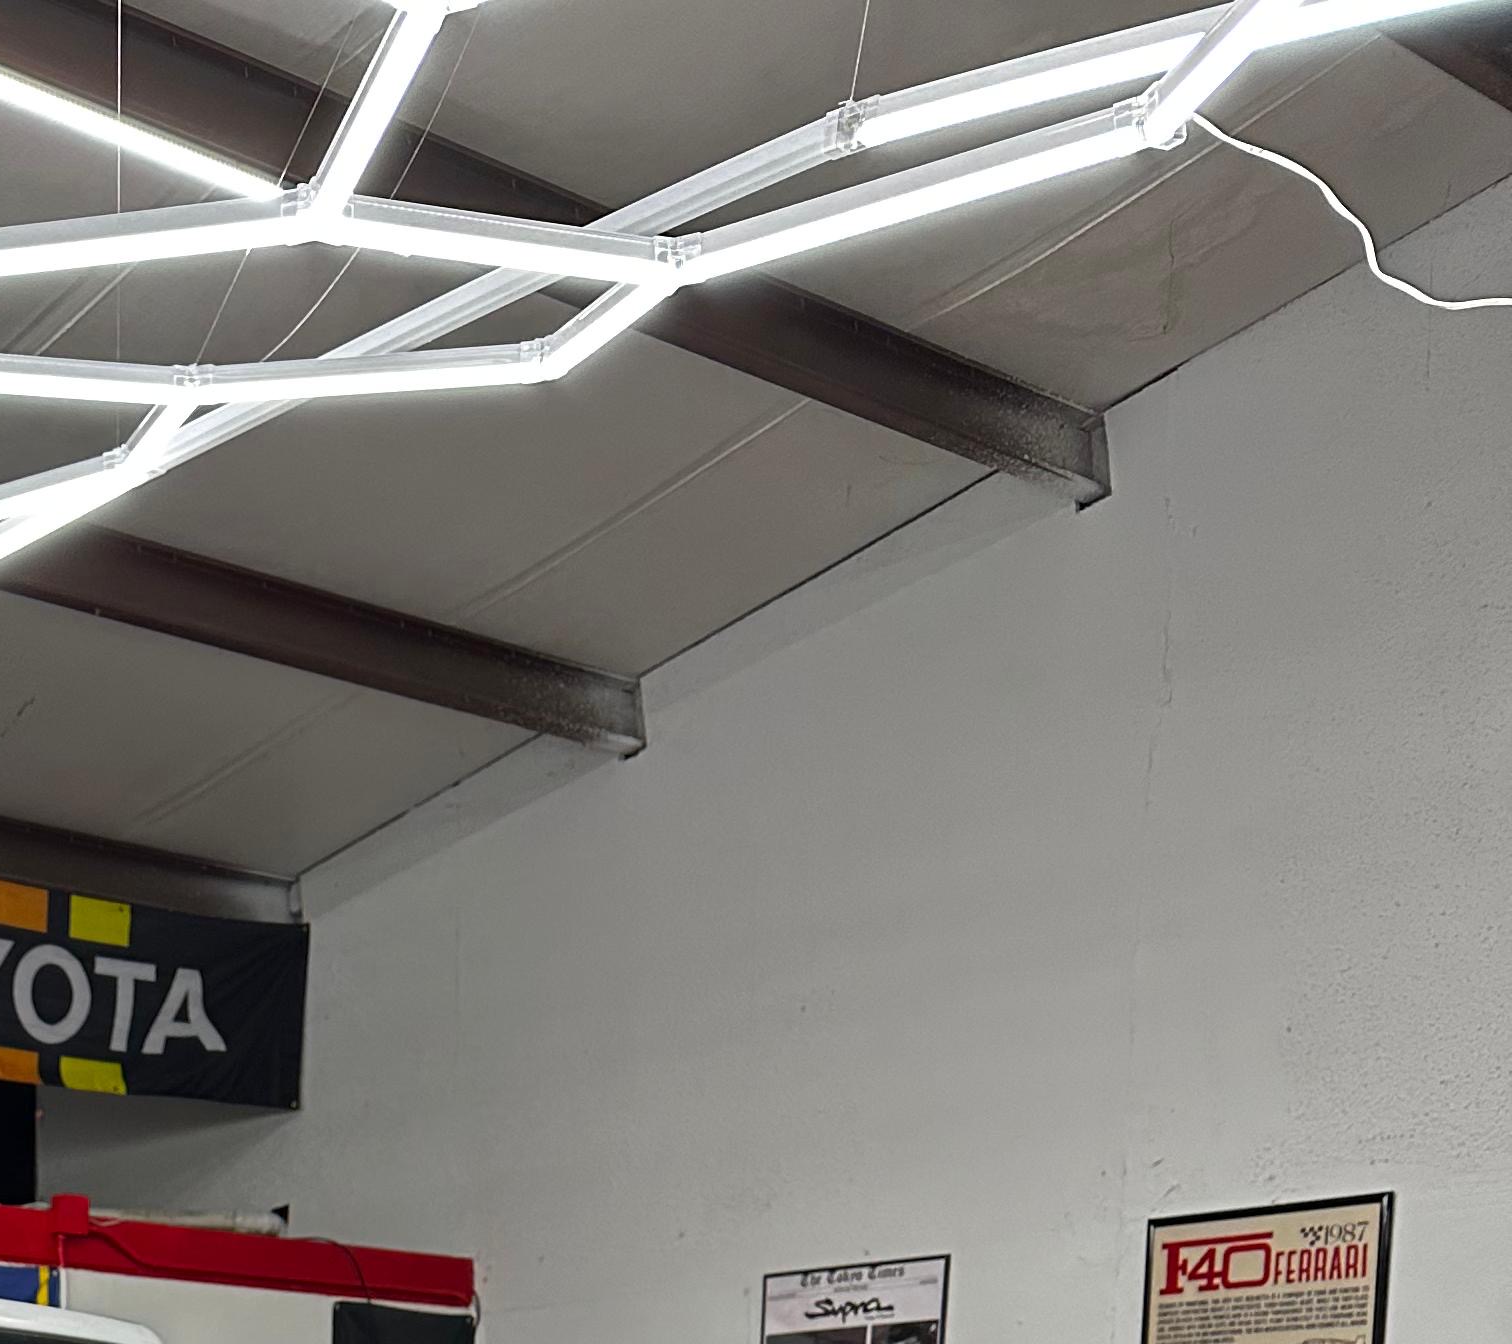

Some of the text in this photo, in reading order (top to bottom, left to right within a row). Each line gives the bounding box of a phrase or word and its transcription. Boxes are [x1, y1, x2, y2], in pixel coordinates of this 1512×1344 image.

[1324, 1221, 1369, 1245] 1987
[1159, 1231, 1369, 1296] F40 FERRARI
[804, 1297, 894, 1323] Supra
